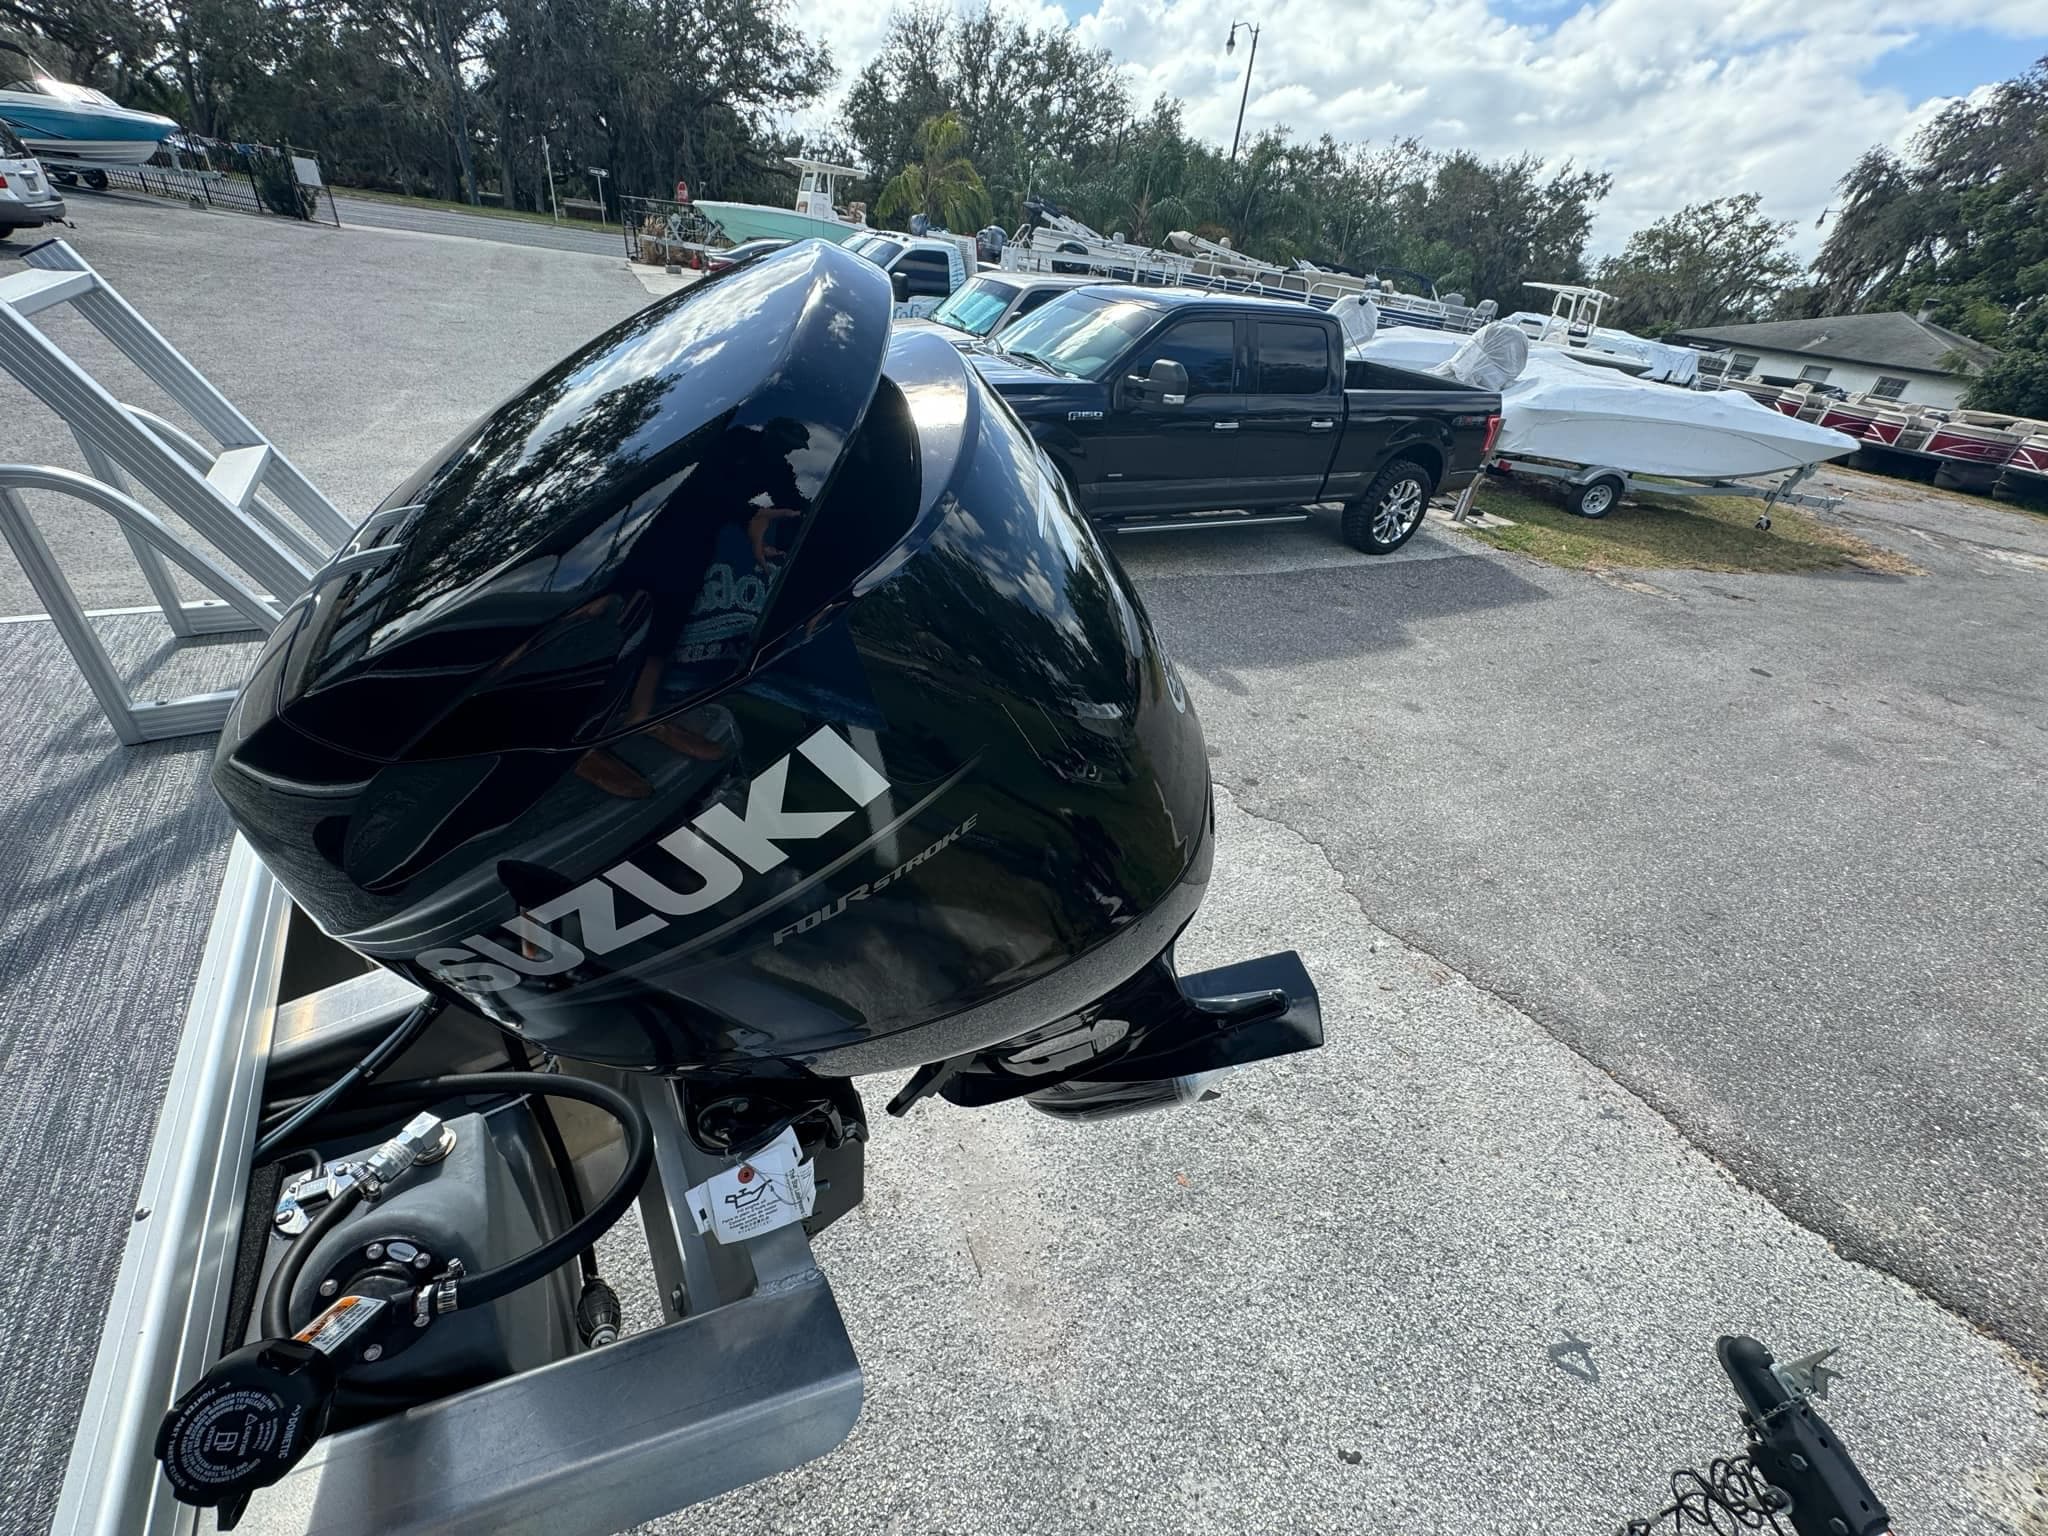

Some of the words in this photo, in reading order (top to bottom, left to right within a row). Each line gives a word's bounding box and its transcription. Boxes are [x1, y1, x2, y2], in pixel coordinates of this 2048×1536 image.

[416, 724, 890, 992] SUZUKI
[184, 1388, 216, 1416] TIGHTEN
[171, 1416, 186, 1438] PAST
[238, 1426, 252, 1456] CAUTION
[278, 1416, 299, 1459] DOMETIC
[168, 1439, 176, 1466] THREE
[169, 1466, 187, 1487] CLICKS
